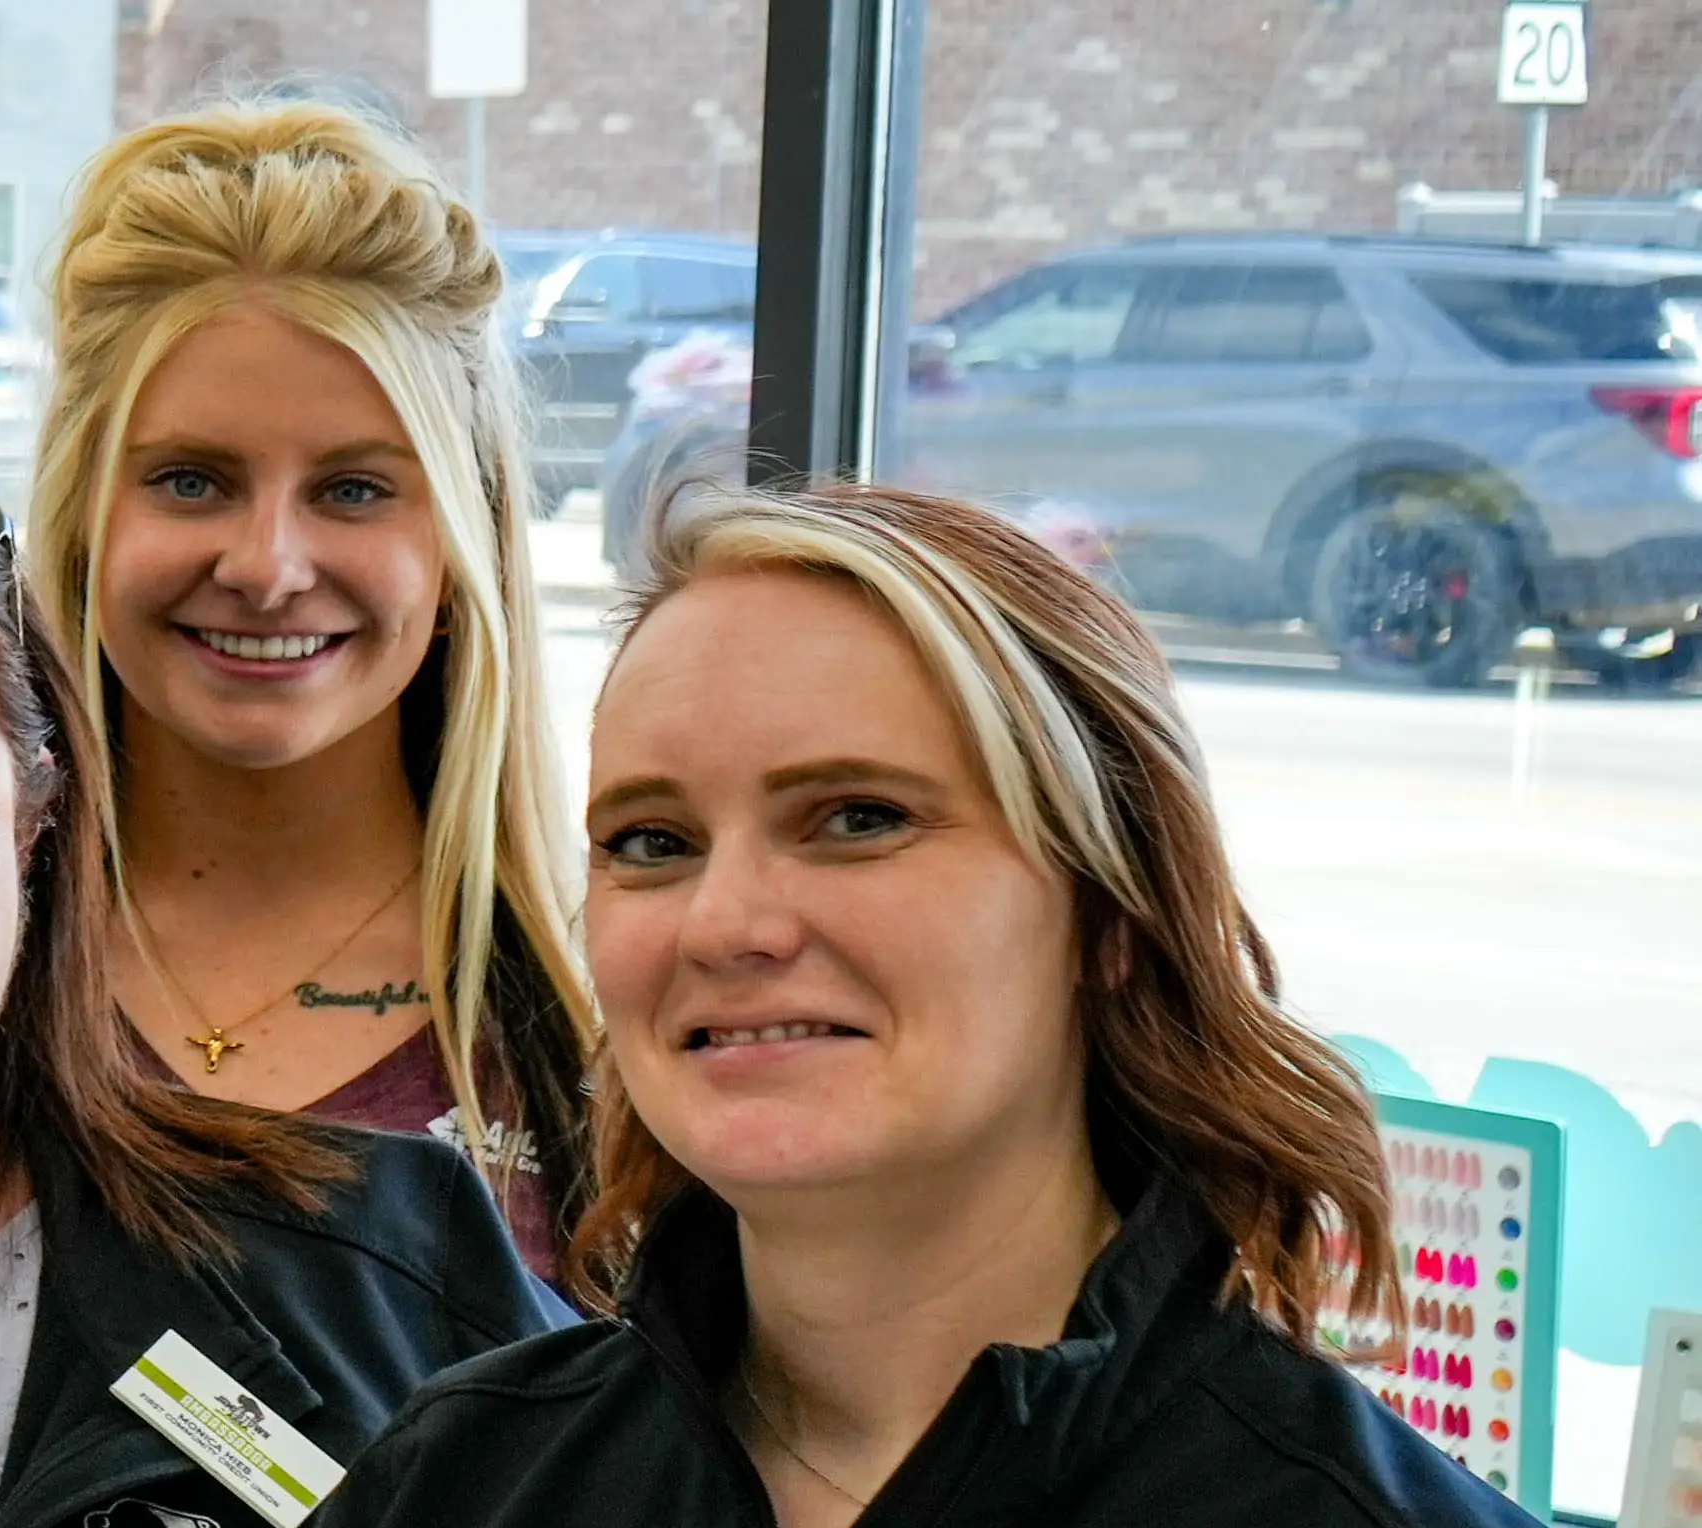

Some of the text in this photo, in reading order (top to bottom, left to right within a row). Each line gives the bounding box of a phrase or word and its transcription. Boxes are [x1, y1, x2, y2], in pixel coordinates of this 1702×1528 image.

[1514, 21, 1573, 87] 20
[138, 1391, 164, 1414] FIRST
[176, 1413, 253, 1476] MONICA HIEB
